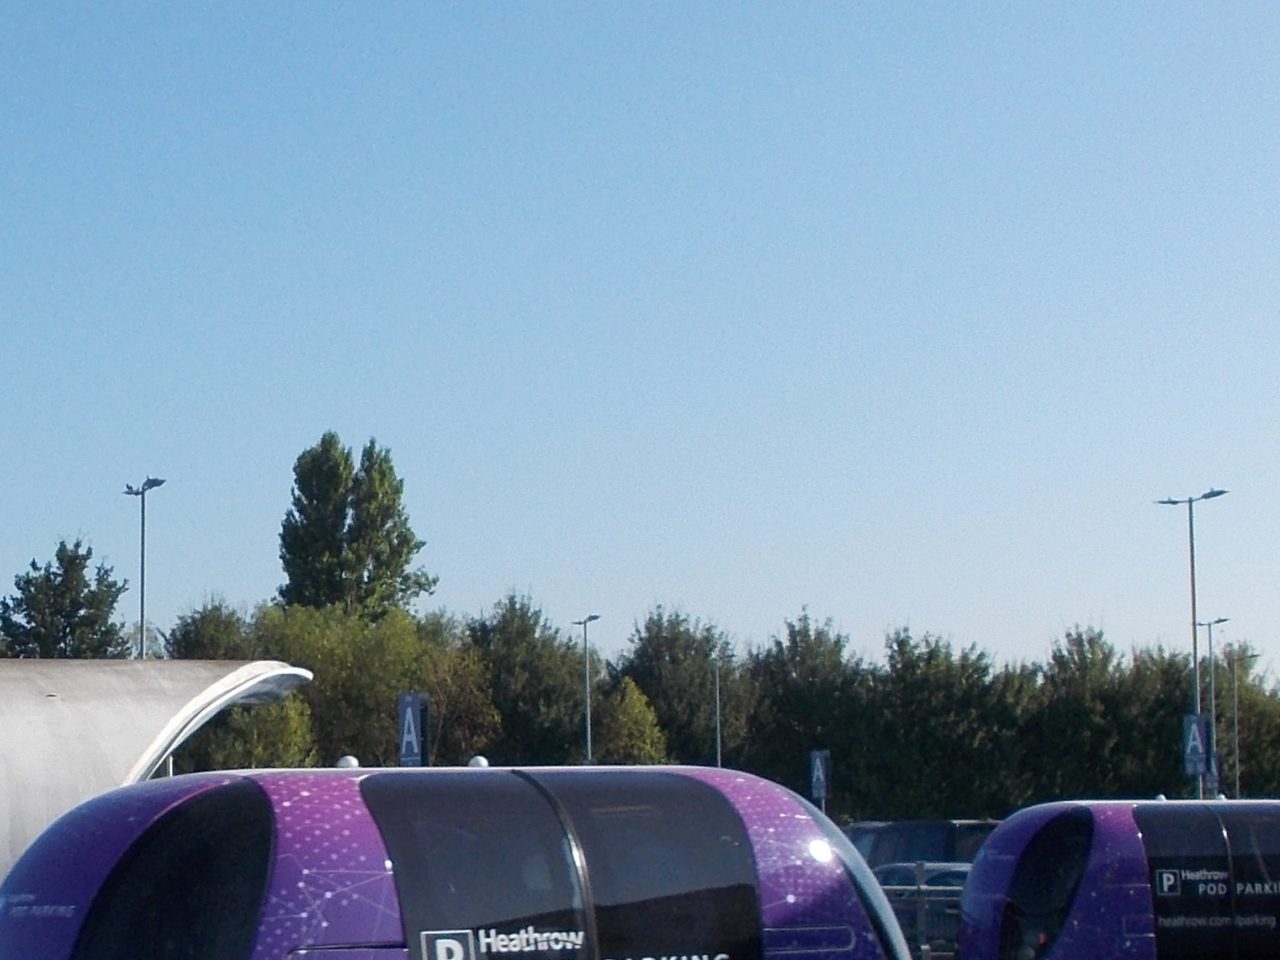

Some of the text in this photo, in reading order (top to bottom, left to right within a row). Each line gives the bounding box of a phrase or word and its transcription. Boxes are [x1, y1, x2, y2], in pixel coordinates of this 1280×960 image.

[402, 707, 419, 753] A
[1186, 723, 1204, 754] A
[812, 758, 825, 781] A
[1162, 873, 1176, 893] P
[1181, 869, 1229, 880] Heathrow
[1199, 882, 1280, 895] POD PARKI
[478, 926, 585, 954] Heathrow
